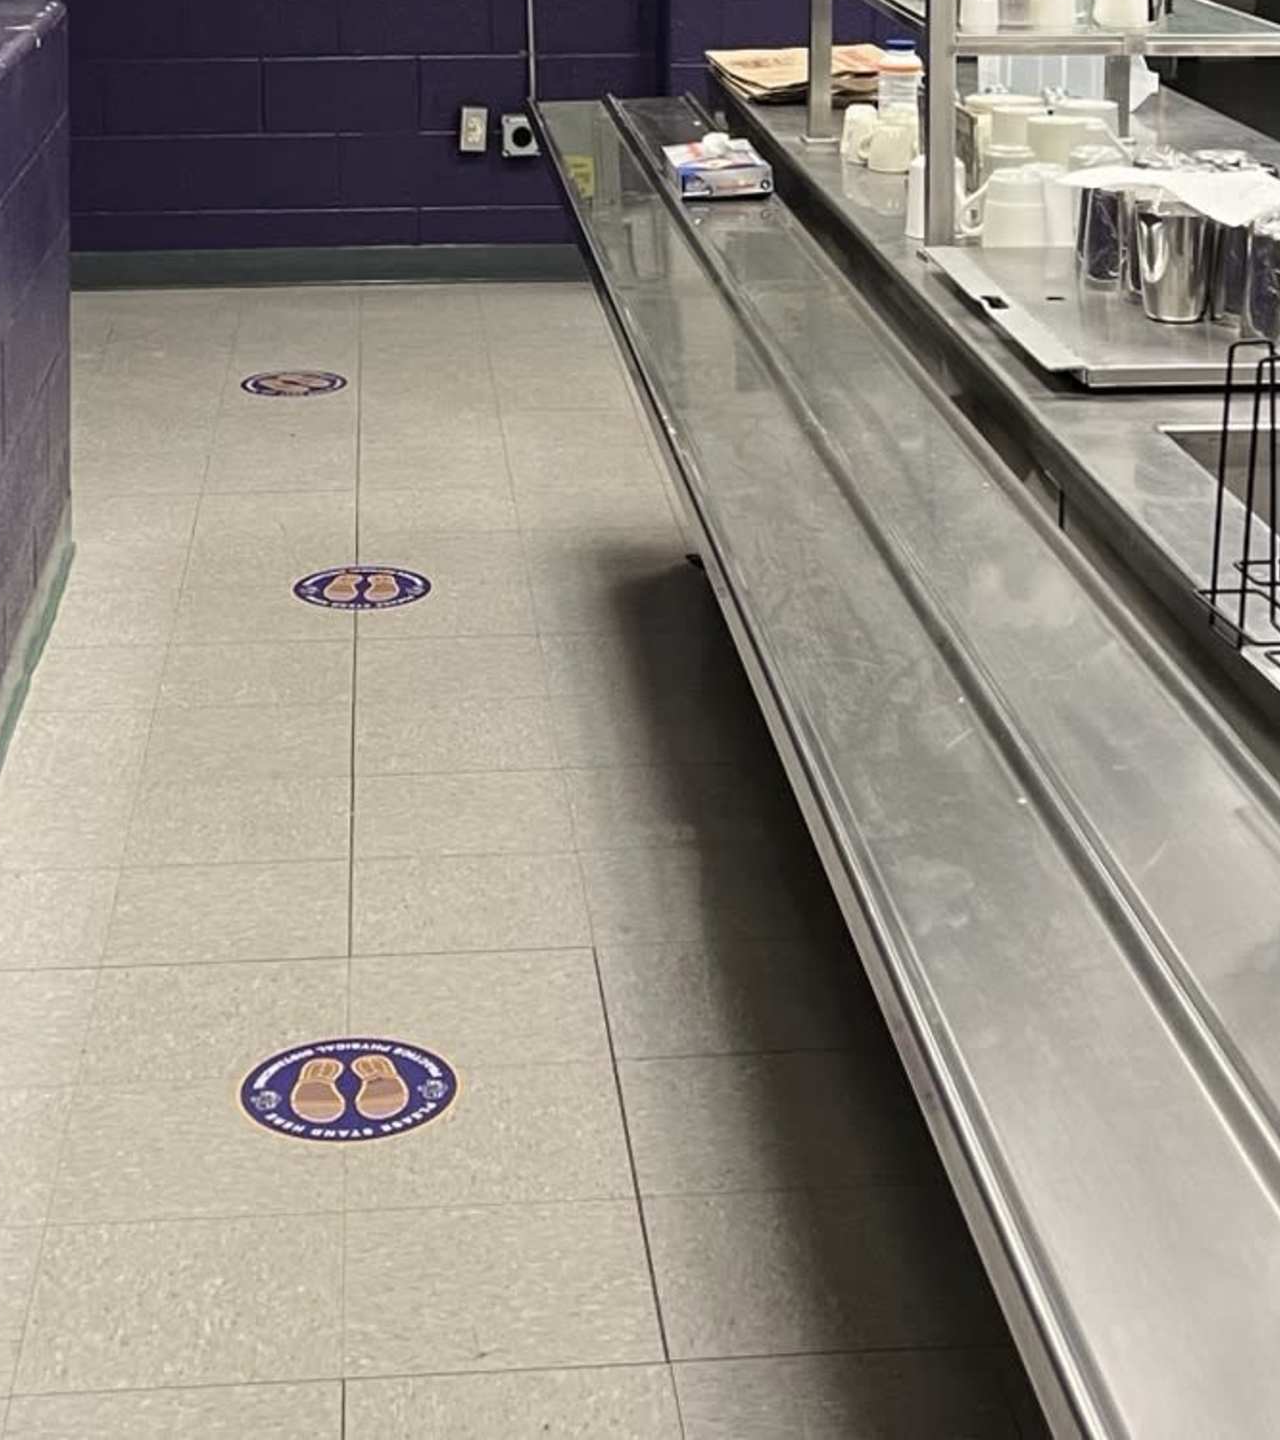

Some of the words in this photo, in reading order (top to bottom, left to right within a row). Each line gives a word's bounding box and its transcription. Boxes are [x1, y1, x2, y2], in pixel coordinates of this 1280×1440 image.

[315, 1042, 392, 1054] PHYSICAL
[264, 1112, 307, 1133] HERE
[380, 1102, 438, 1133] PLEASE
[310, 1127, 374, 1138] STAND
